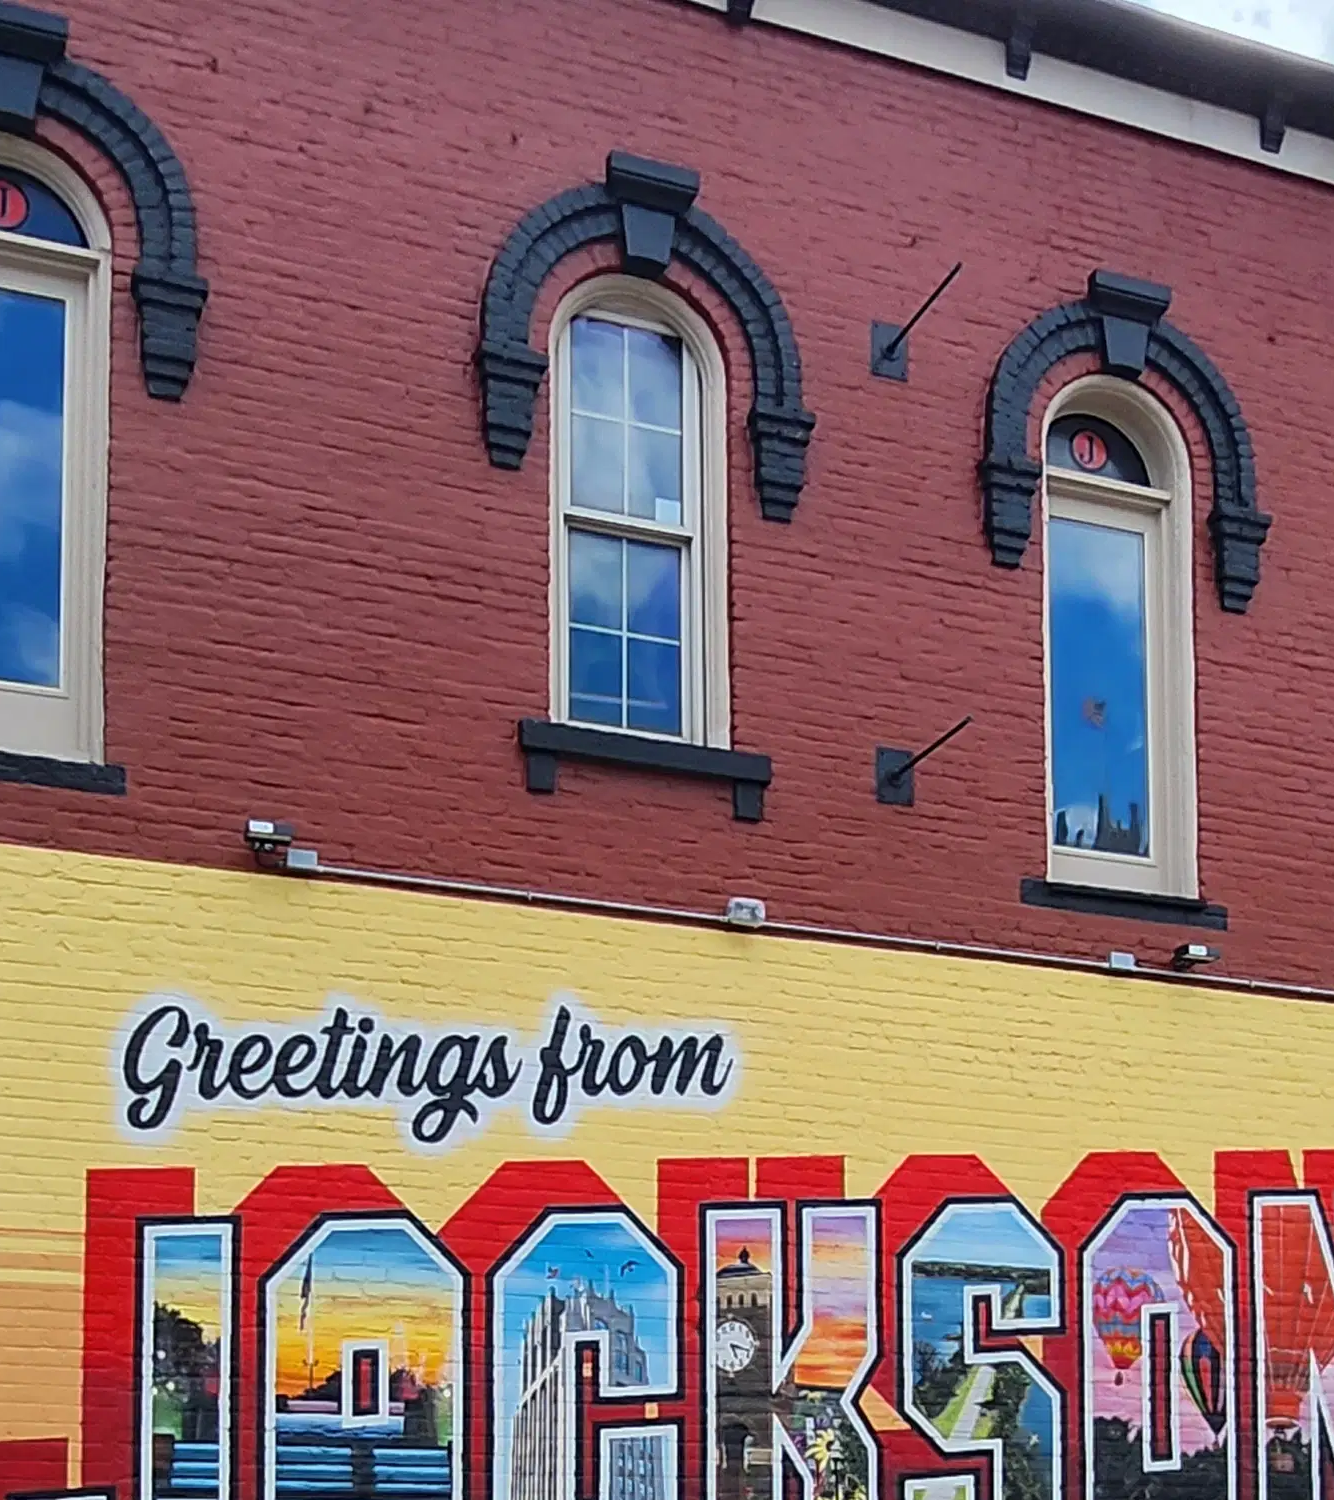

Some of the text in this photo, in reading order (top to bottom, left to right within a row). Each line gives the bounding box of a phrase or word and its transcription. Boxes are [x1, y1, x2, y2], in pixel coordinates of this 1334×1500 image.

[1078, 435, 1094, 464] J
[123, 1004, 733, 1143] Greetings from
